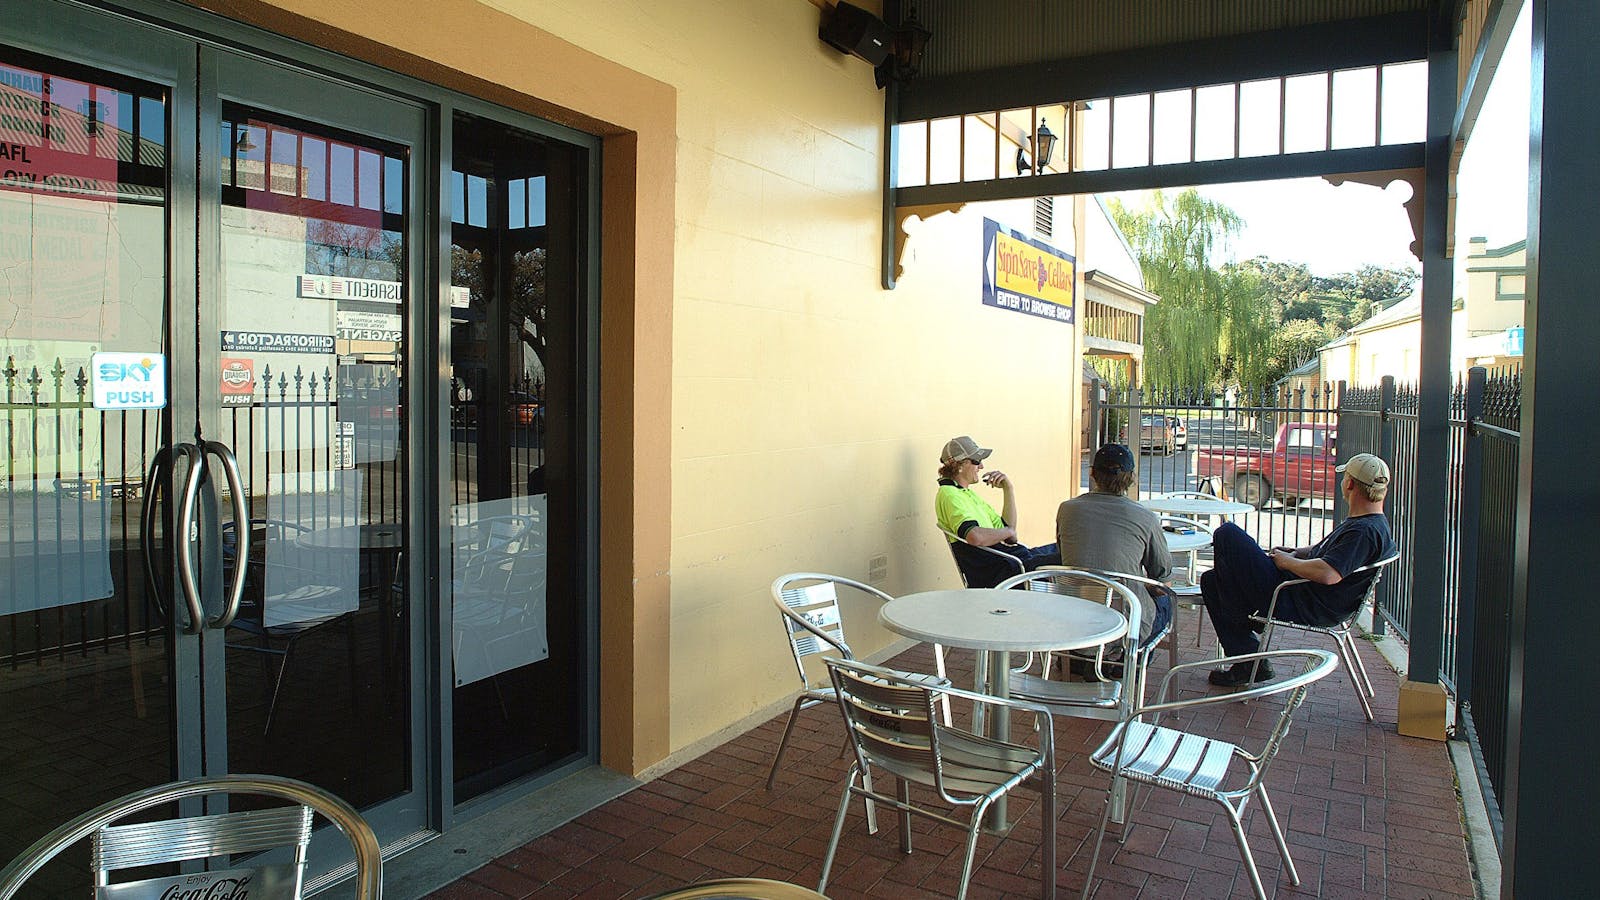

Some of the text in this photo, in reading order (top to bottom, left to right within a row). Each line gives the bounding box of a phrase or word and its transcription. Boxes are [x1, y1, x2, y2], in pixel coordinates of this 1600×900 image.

[0, 142, 31, 164] AFL
[0, 169, 36, 191] OW
[1019, 250, 1038, 282] Save
[1047, 261, 1073, 294] Cellars
[996, 290, 1072, 321] ENTER TO BROWSE SHOP
[100, 358, 157, 382] SKY
[106, 391, 154, 404] PUSH
[223, 395, 251, 404] PUSH
[186, 874, 212, 885] Enjoy
